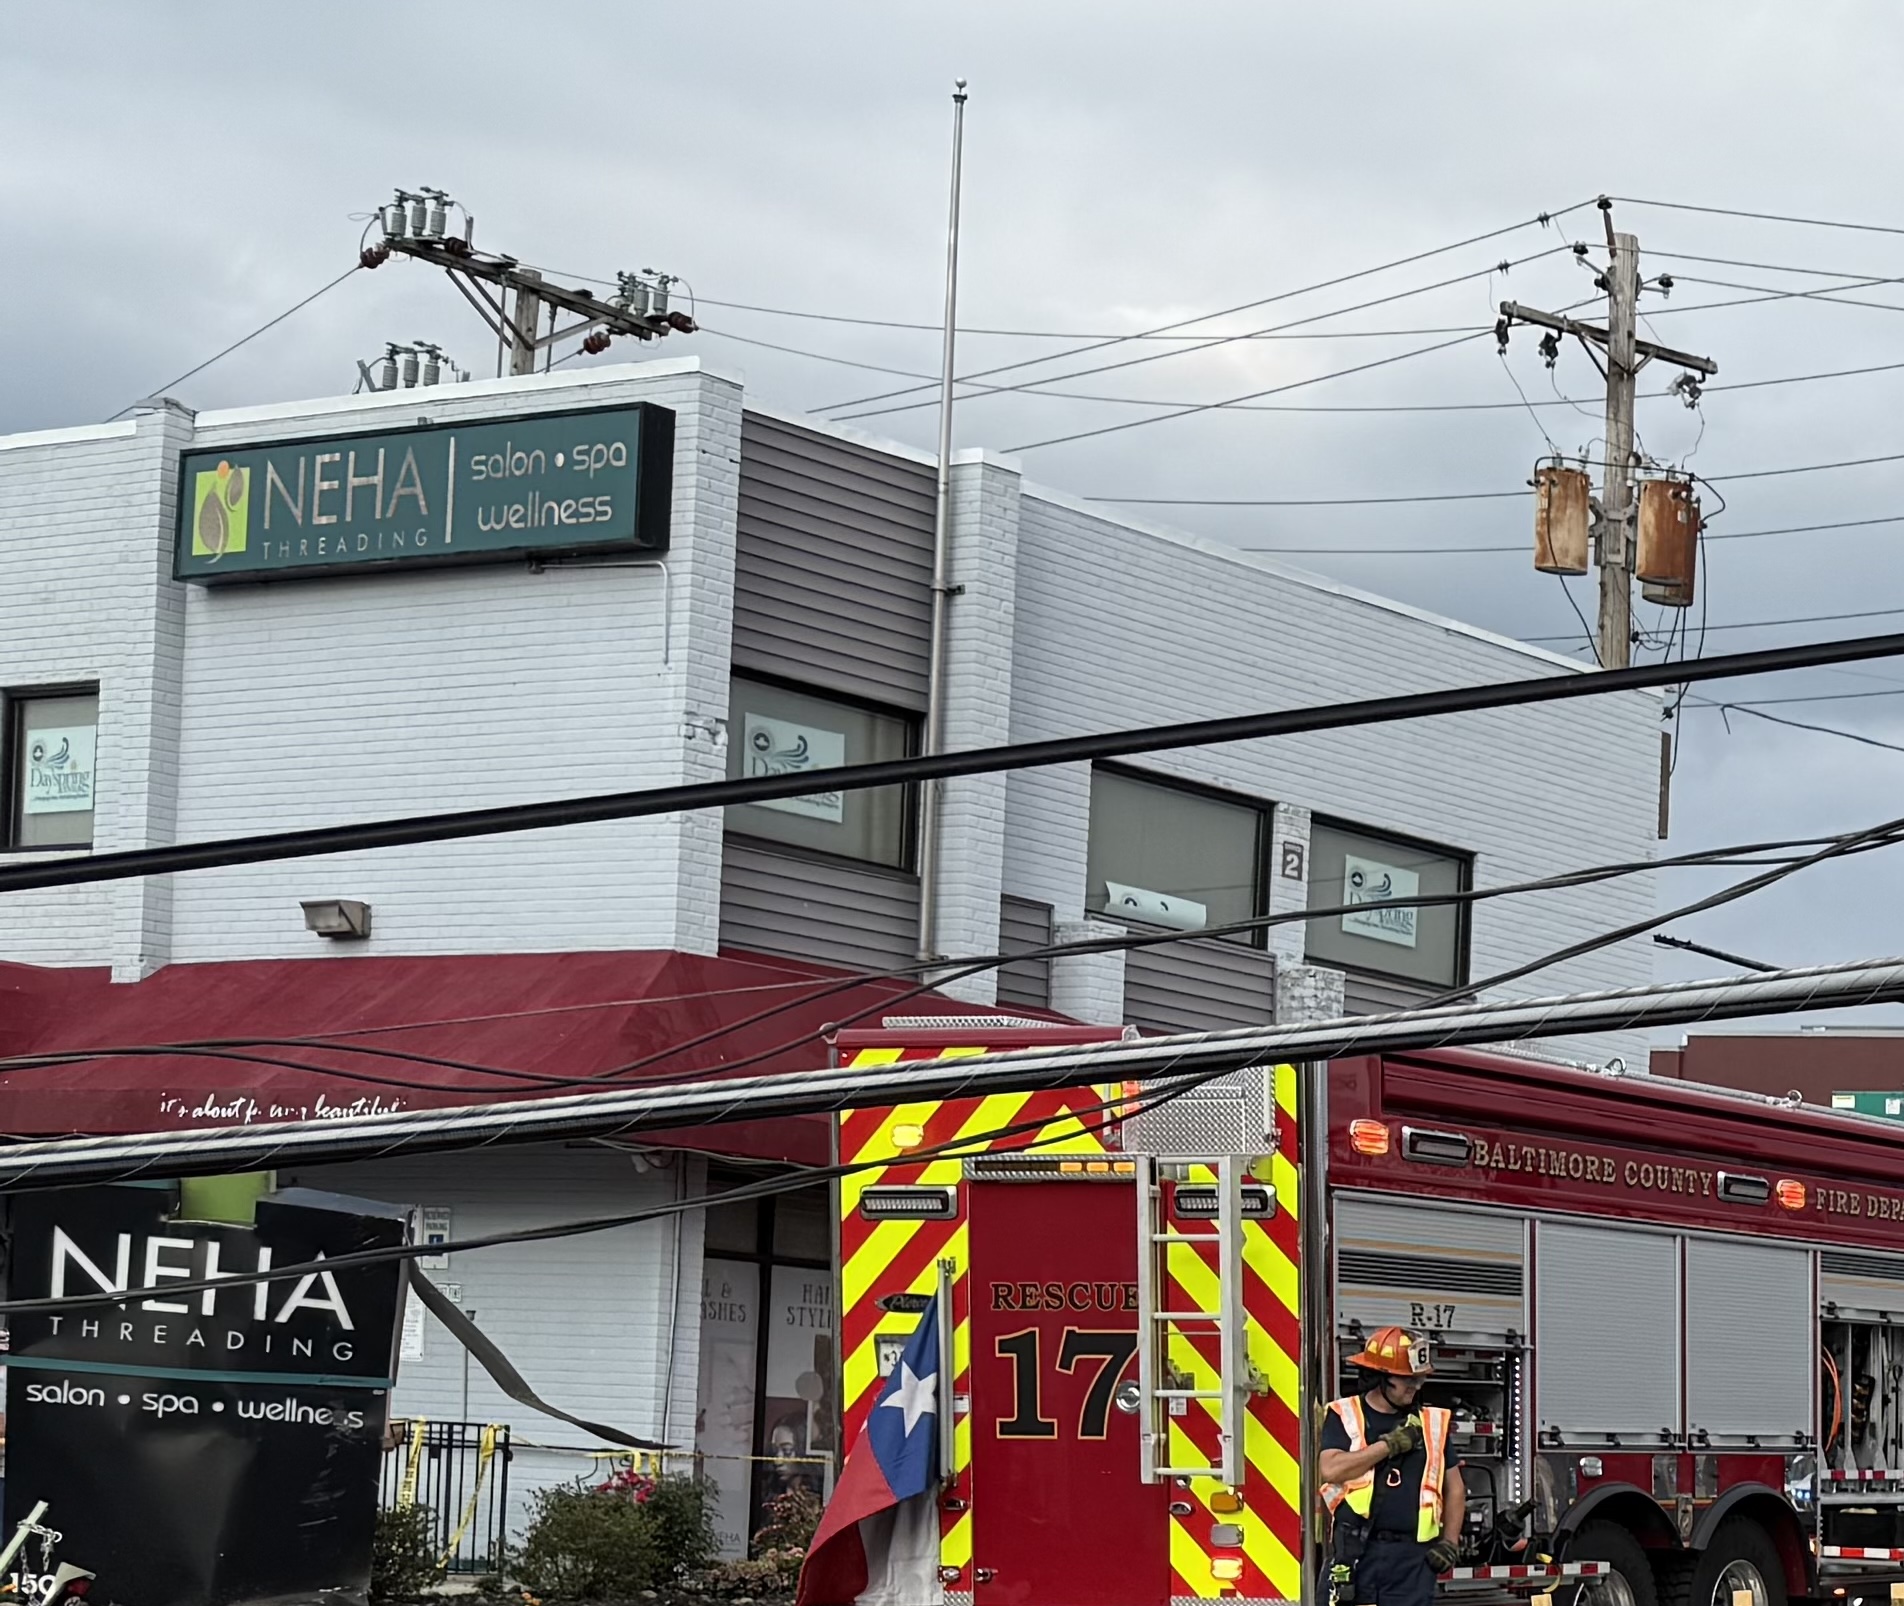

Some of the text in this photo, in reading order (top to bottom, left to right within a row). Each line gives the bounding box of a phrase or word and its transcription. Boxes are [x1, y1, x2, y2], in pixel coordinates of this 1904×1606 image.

[471, 441, 627, 480] salon spa
[264, 446, 428, 529] NEHA
[478, 491, 613, 531] wellness
[262, 528, 428, 561] THREADING
[1284, 853, 1299, 879] 2
[1473, 1142, 1616, 1184] BALTIMORE
[1625, 1161, 1712, 1196] COUNTY
[1816, 1188, 1860, 1216] FIRE
[51, 1224, 355, 1332] NEHA
[989, 1281, 1140, 1312] RESCUE
[1410, 1302, 1456, 1328] R-17
[49, 1316, 355, 1362] THREADING
[1418, 1347, 1427, 1365] 6
[26, 1379, 105, 1407] salon
[142, 1392, 199, 1418] spa
[995, 1325, 1140, 1440] 17
